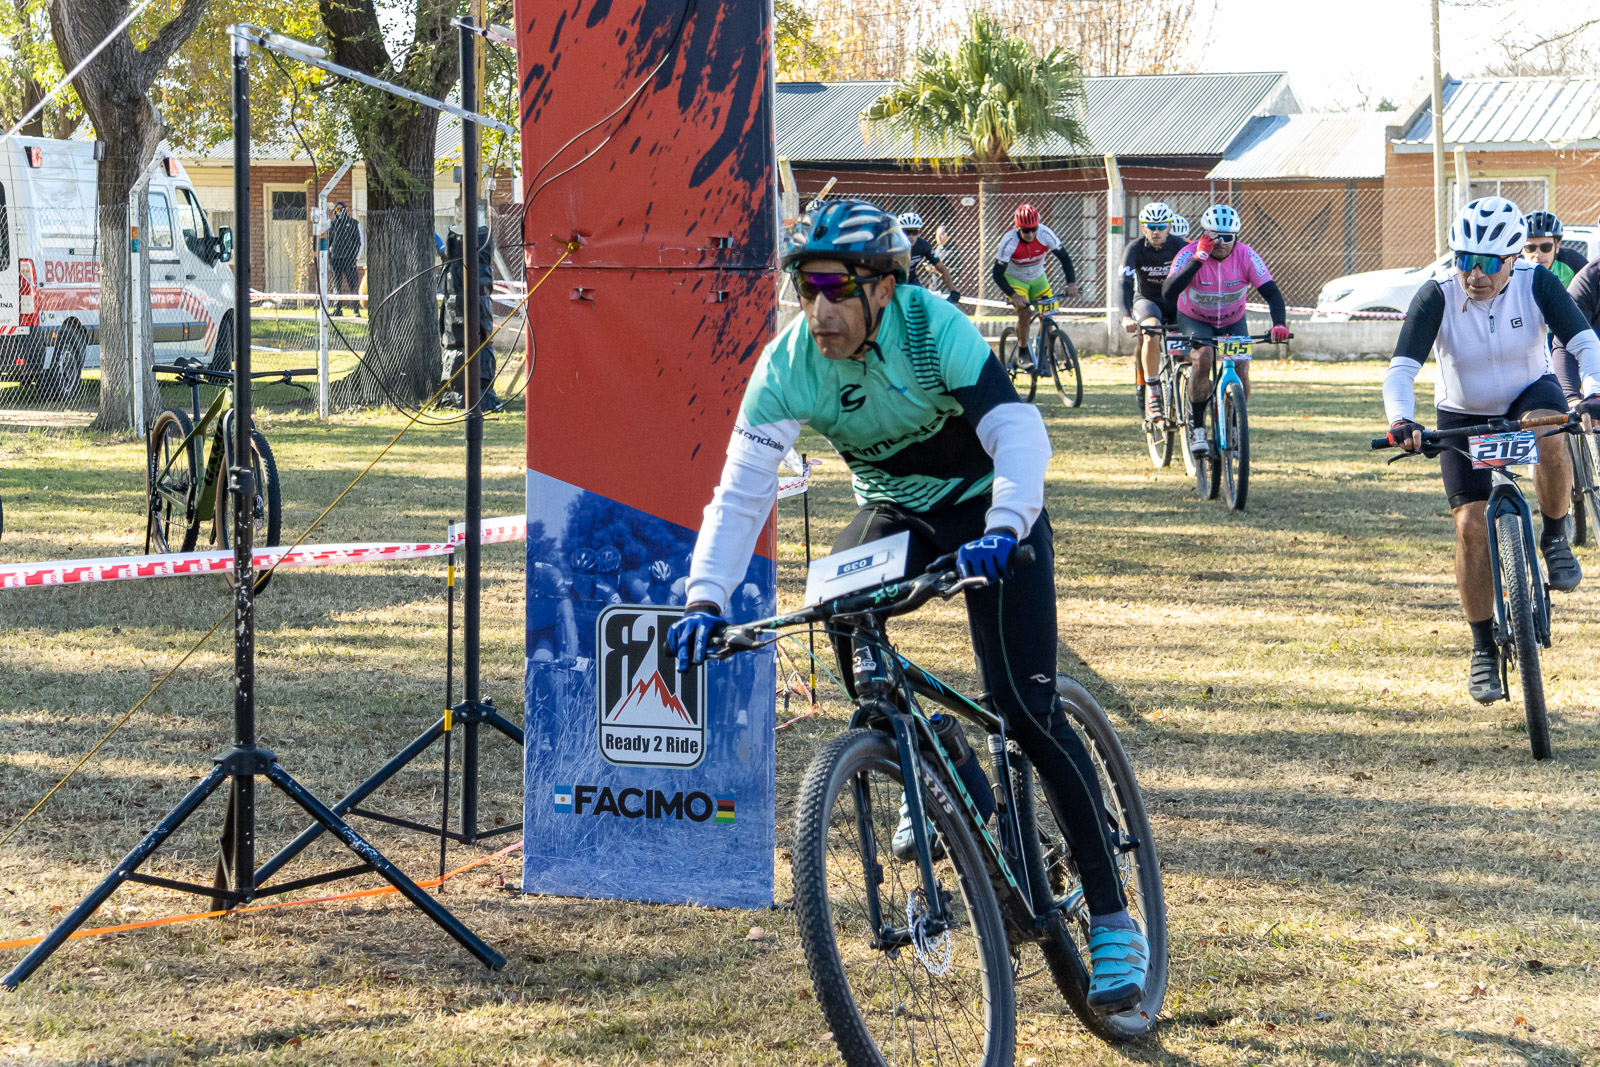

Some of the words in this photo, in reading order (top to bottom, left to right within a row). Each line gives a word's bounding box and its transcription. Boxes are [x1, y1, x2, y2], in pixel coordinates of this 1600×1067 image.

[1223, 342, 1249, 355] 145
[1478, 440, 1531, 460] 216
[605, 733, 651, 753] Ready
[653, 735, 663, 752] 2
[666, 736, 699, 754] Ride
[575, 785, 714, 823] FACIMO
